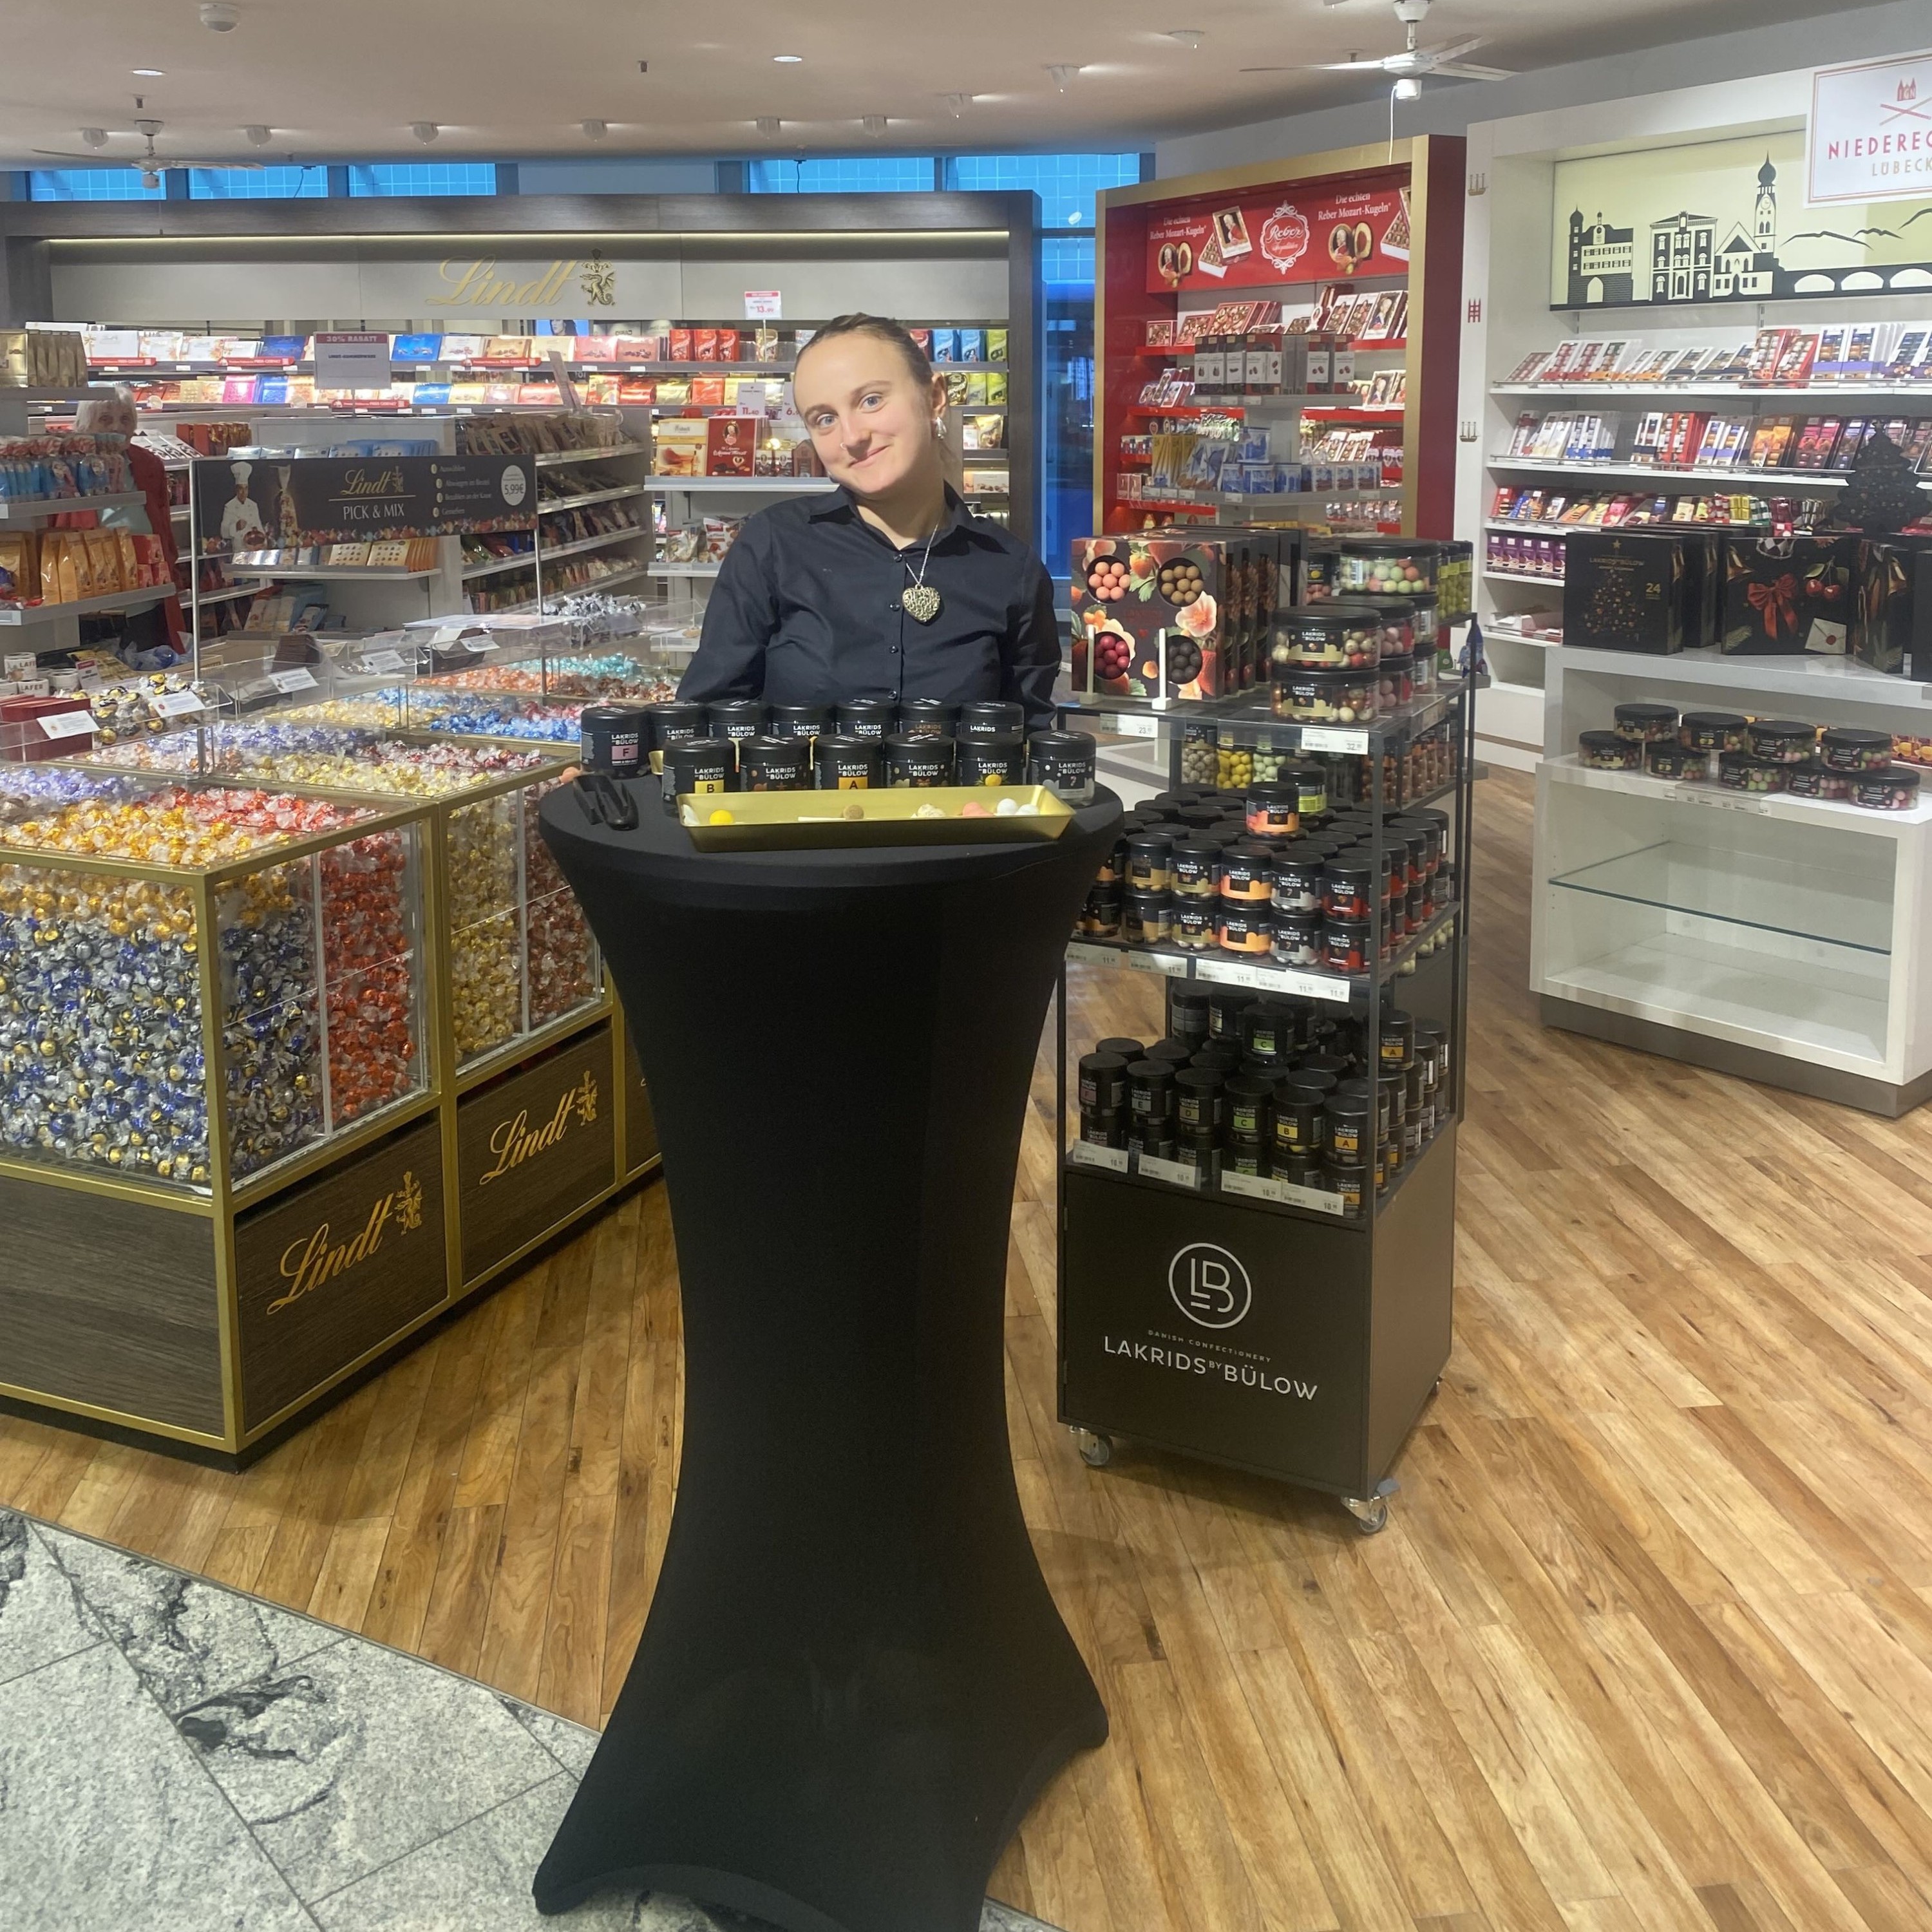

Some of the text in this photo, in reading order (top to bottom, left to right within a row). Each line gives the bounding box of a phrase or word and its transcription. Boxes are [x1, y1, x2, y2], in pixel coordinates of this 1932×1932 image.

[1335, 192, 1370, 205] Die echten
[1318, 210, 1337, 222] Reber
[1150, 229, 1165, 240] Reber
[1265, 224, 1303, 243] Reber
[424, 254, 578, 307] Lindt
[339, 468, 391, 495] Lindt
[504, 484, 524, 495] 5,99€
[343, 503, 404, 520] PICK & MIX
[1645, 582, 1662, 594] 24
[623, 748, 629, 757] F
[707, 784, 714, 793] B
[849, 780, 858, 790] A
[1328, 935, 1350, 943] LAKRIDS
[478, 1087, 576, 1185] Lindt
[1345, 1195, 1352, 1203] A
[266, 1193, 394, 1315] Lindt
[1148, 1329, 1272, 1363] DANISH CONFECTIONERY
[1103, 1335, 1318, 1401] LAKRIDS BY BÜLOW
